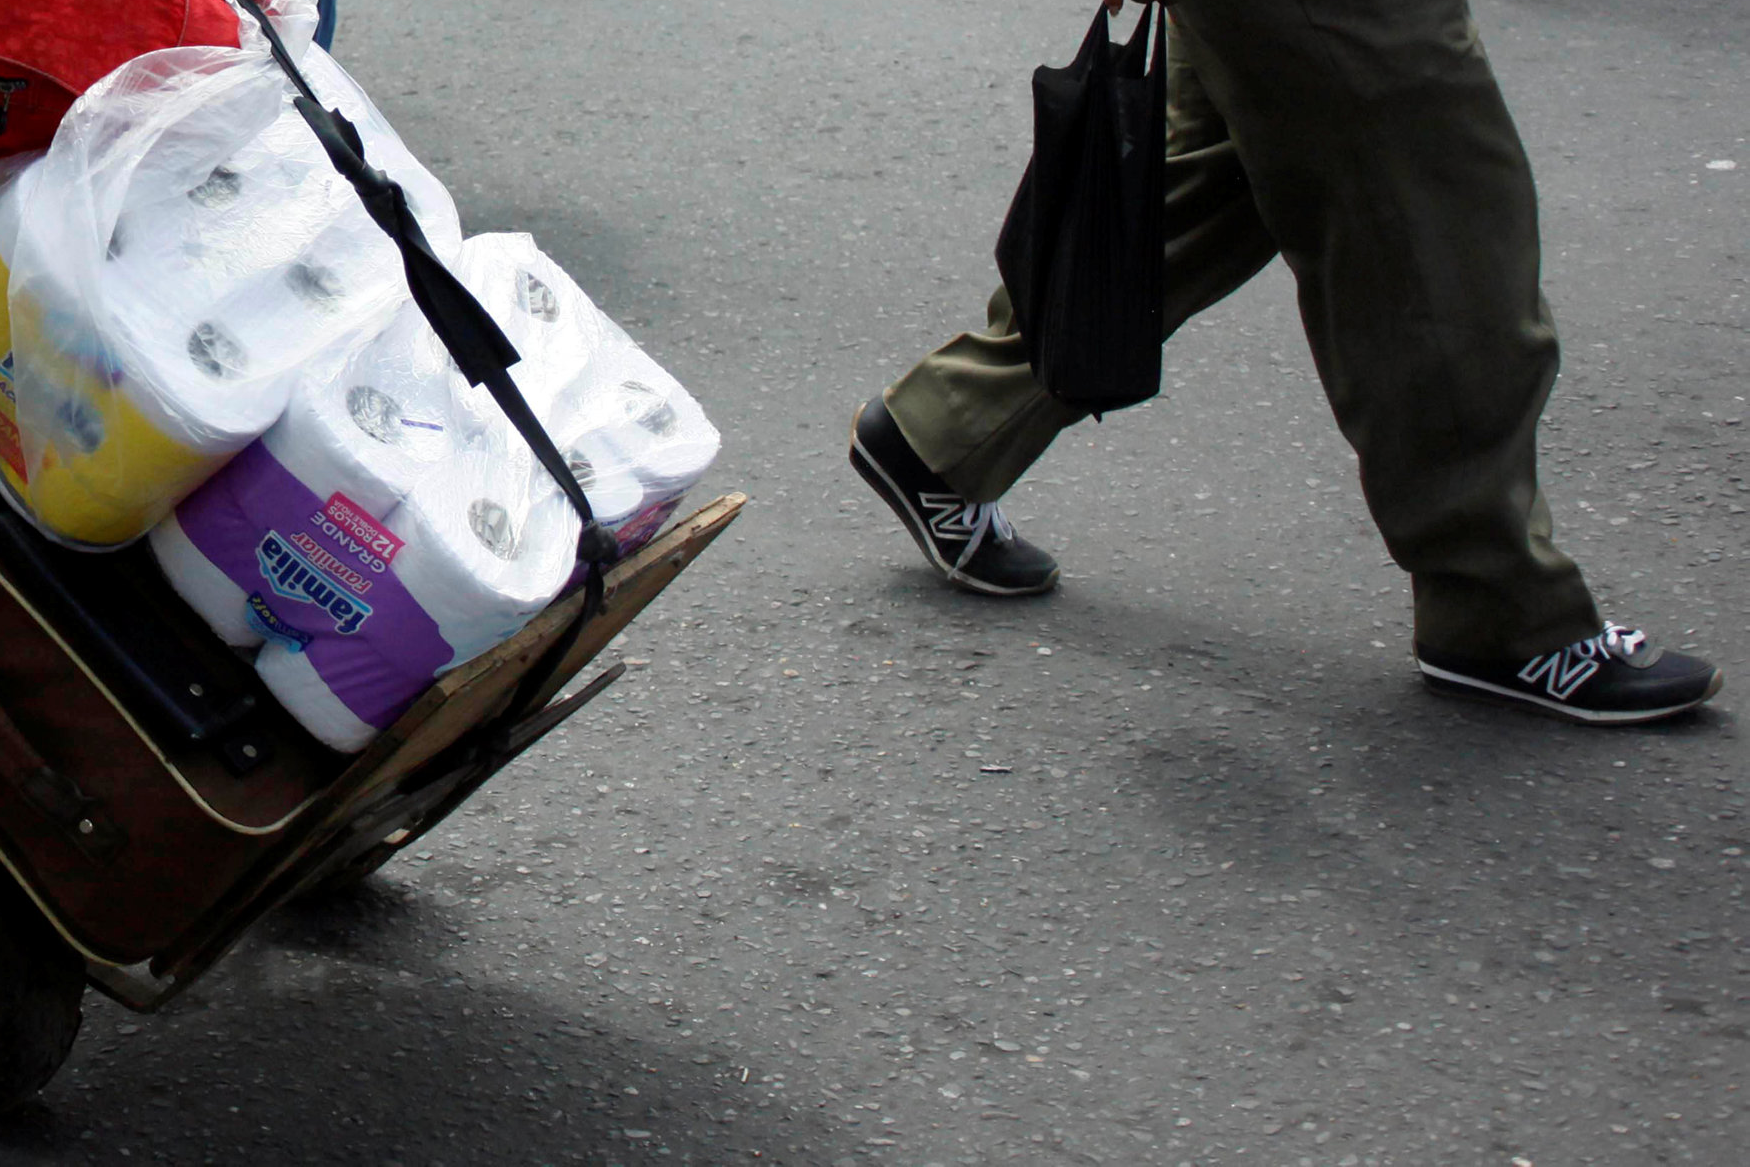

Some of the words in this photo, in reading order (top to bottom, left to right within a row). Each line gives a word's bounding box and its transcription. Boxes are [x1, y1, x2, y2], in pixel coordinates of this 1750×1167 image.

[310, 511, 386, 573] GRANDE
[327, 505, 371, 543] ROLLOS
[371, 533, 395, 559] 12
[260, 536, 366, 635] familia
[290, 532, 373, 595] Familiar
